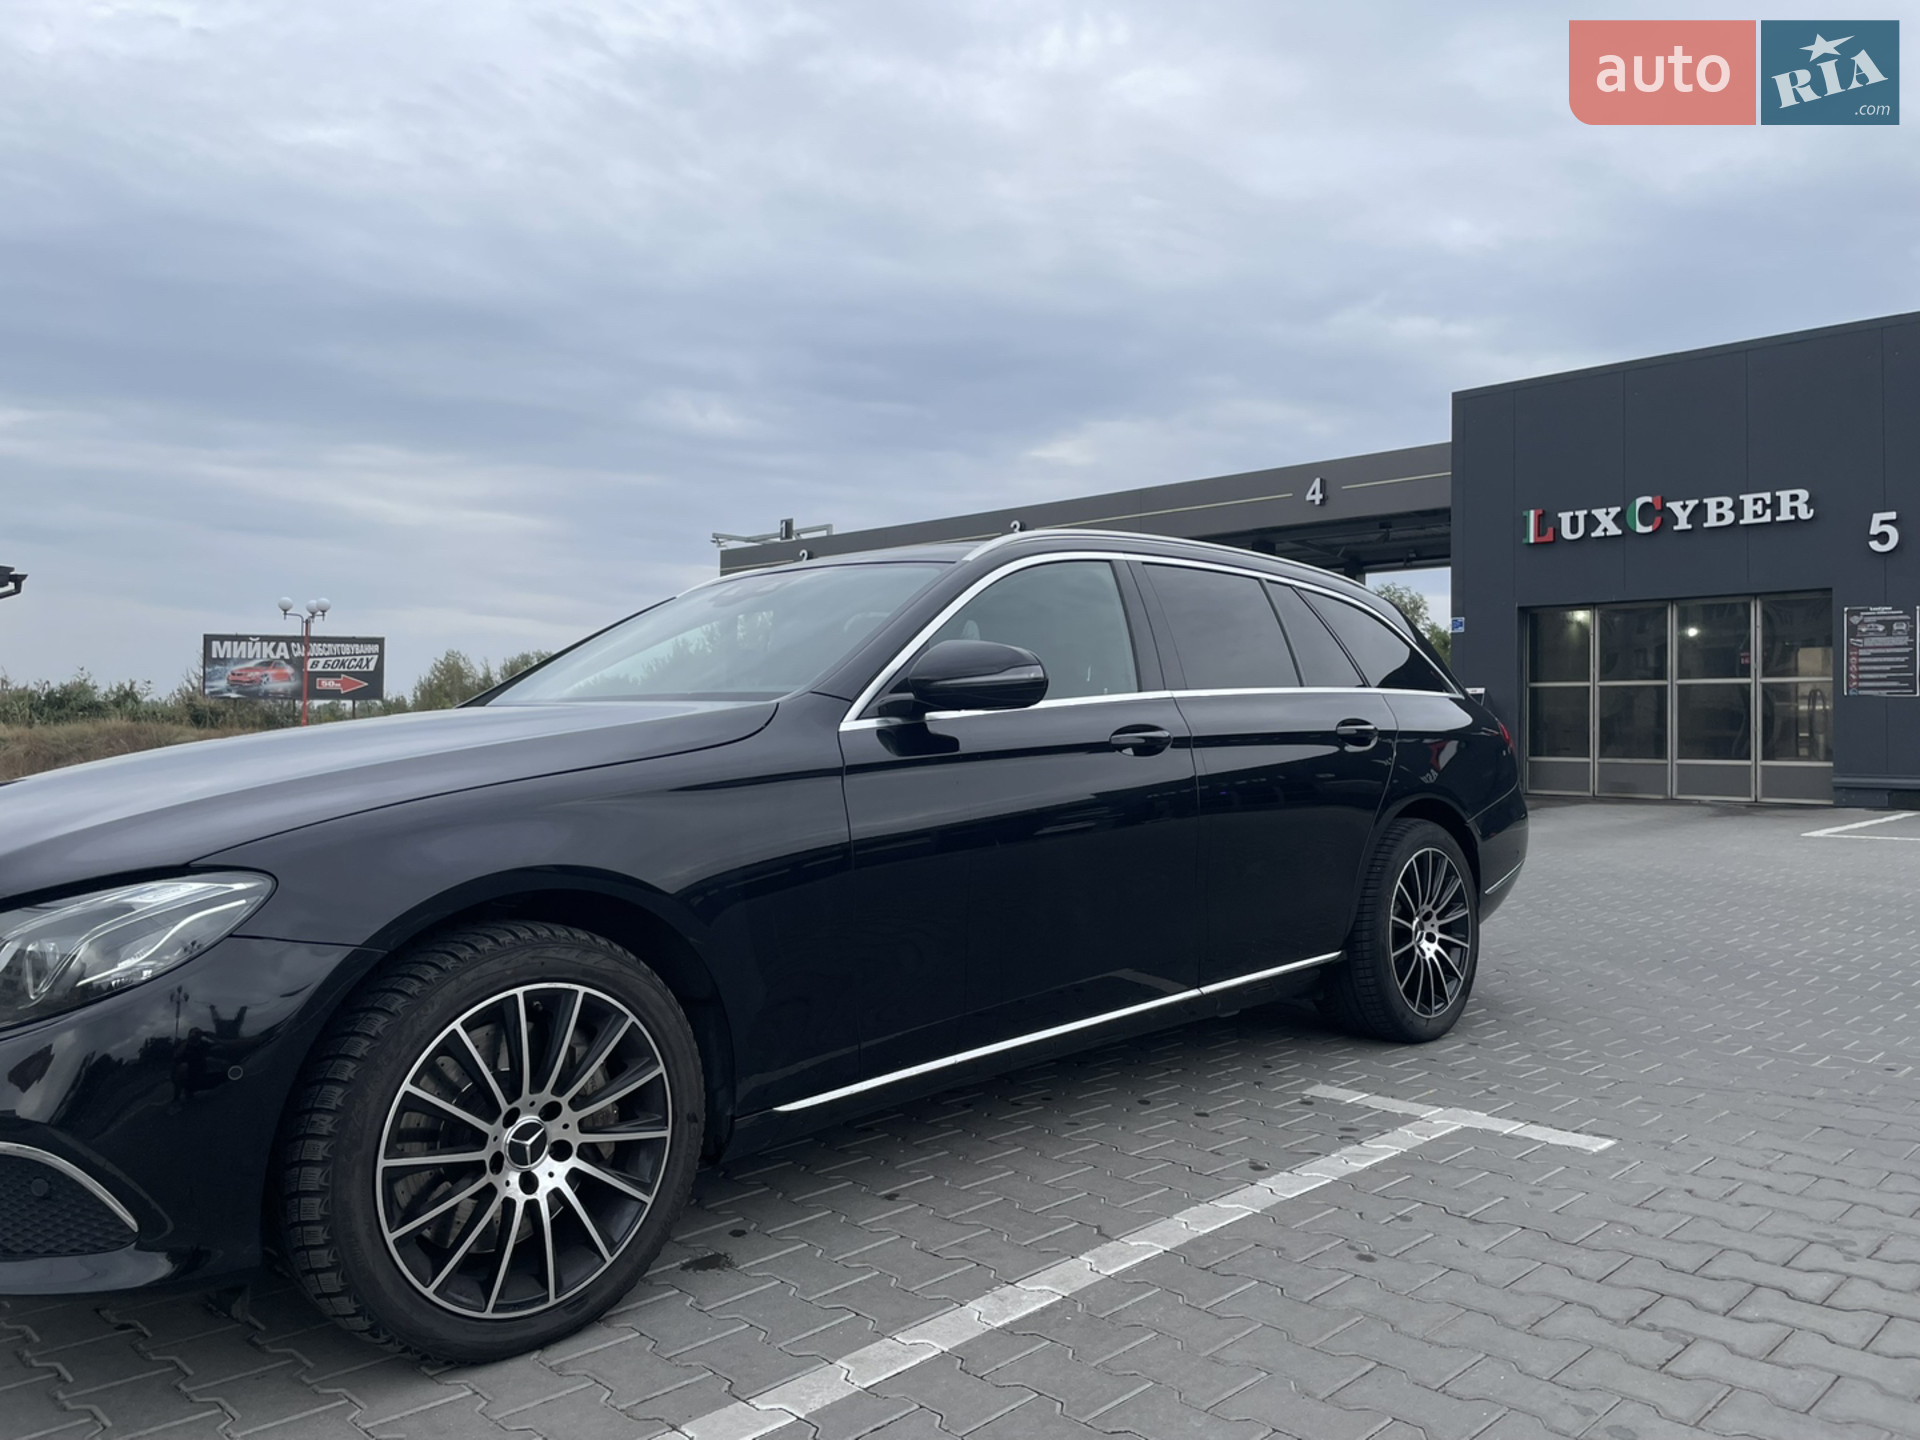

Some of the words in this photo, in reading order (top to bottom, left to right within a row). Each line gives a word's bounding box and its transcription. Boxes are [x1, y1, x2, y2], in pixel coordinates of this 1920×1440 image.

[1305, 477, 1323, 505] 4
[780, 521, 786, 538] 1
[1867, 511, 1900, 553] 5
[211, 637, 290, 660] МИЙКА
[310, 660, 320, 670] В
[322, 657, 375, 670] БОКСАХ
